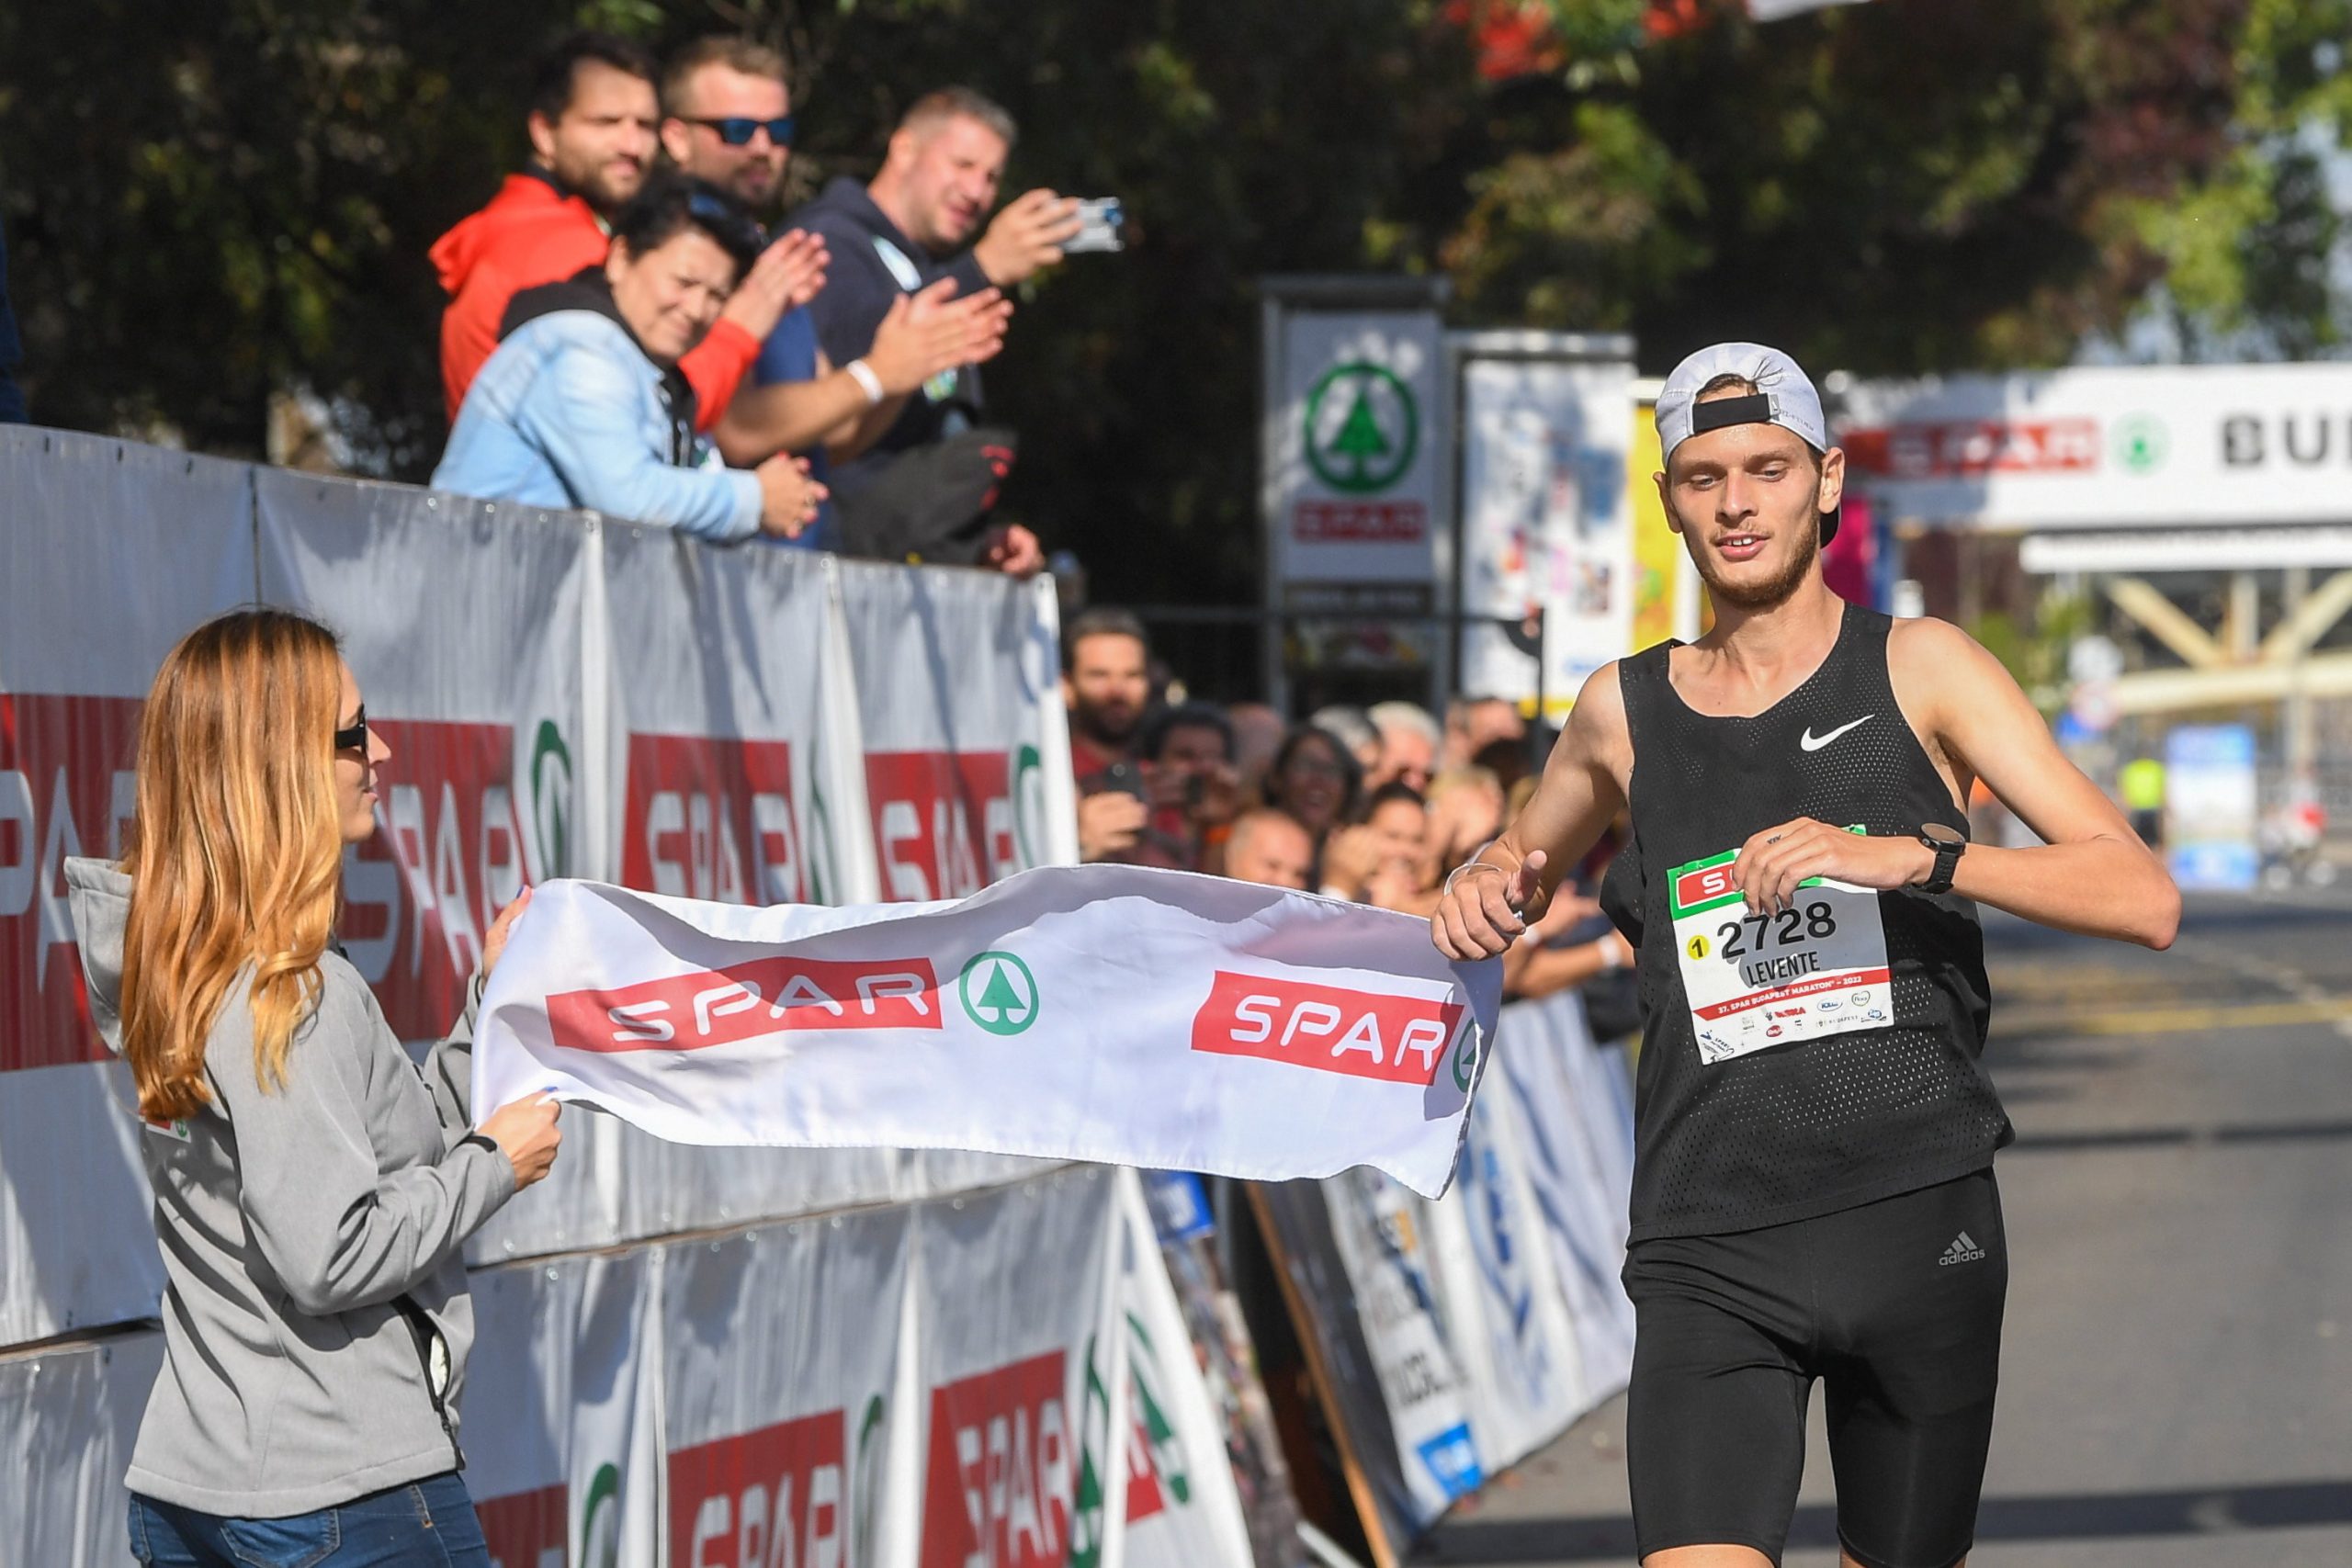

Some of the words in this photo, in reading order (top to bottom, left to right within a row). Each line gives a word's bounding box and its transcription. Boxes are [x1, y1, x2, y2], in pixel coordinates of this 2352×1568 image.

[2223, 413, 2352, 467] BU
[1717, 902, 1836, 959] 2728
[1731, 1000, 1751, 1010] SPAR
[1752, 988, 1790, 1005] BUDAPEST
[1843, 976, 1862, 986] 2022
[1747, 952, 1820, 986] LEVENTE
[607, 973, 929, 1042] SPAR
[1229, 995, 1446, 1069] SPAR
[1939, 1249, 1985, 1266] adidas
